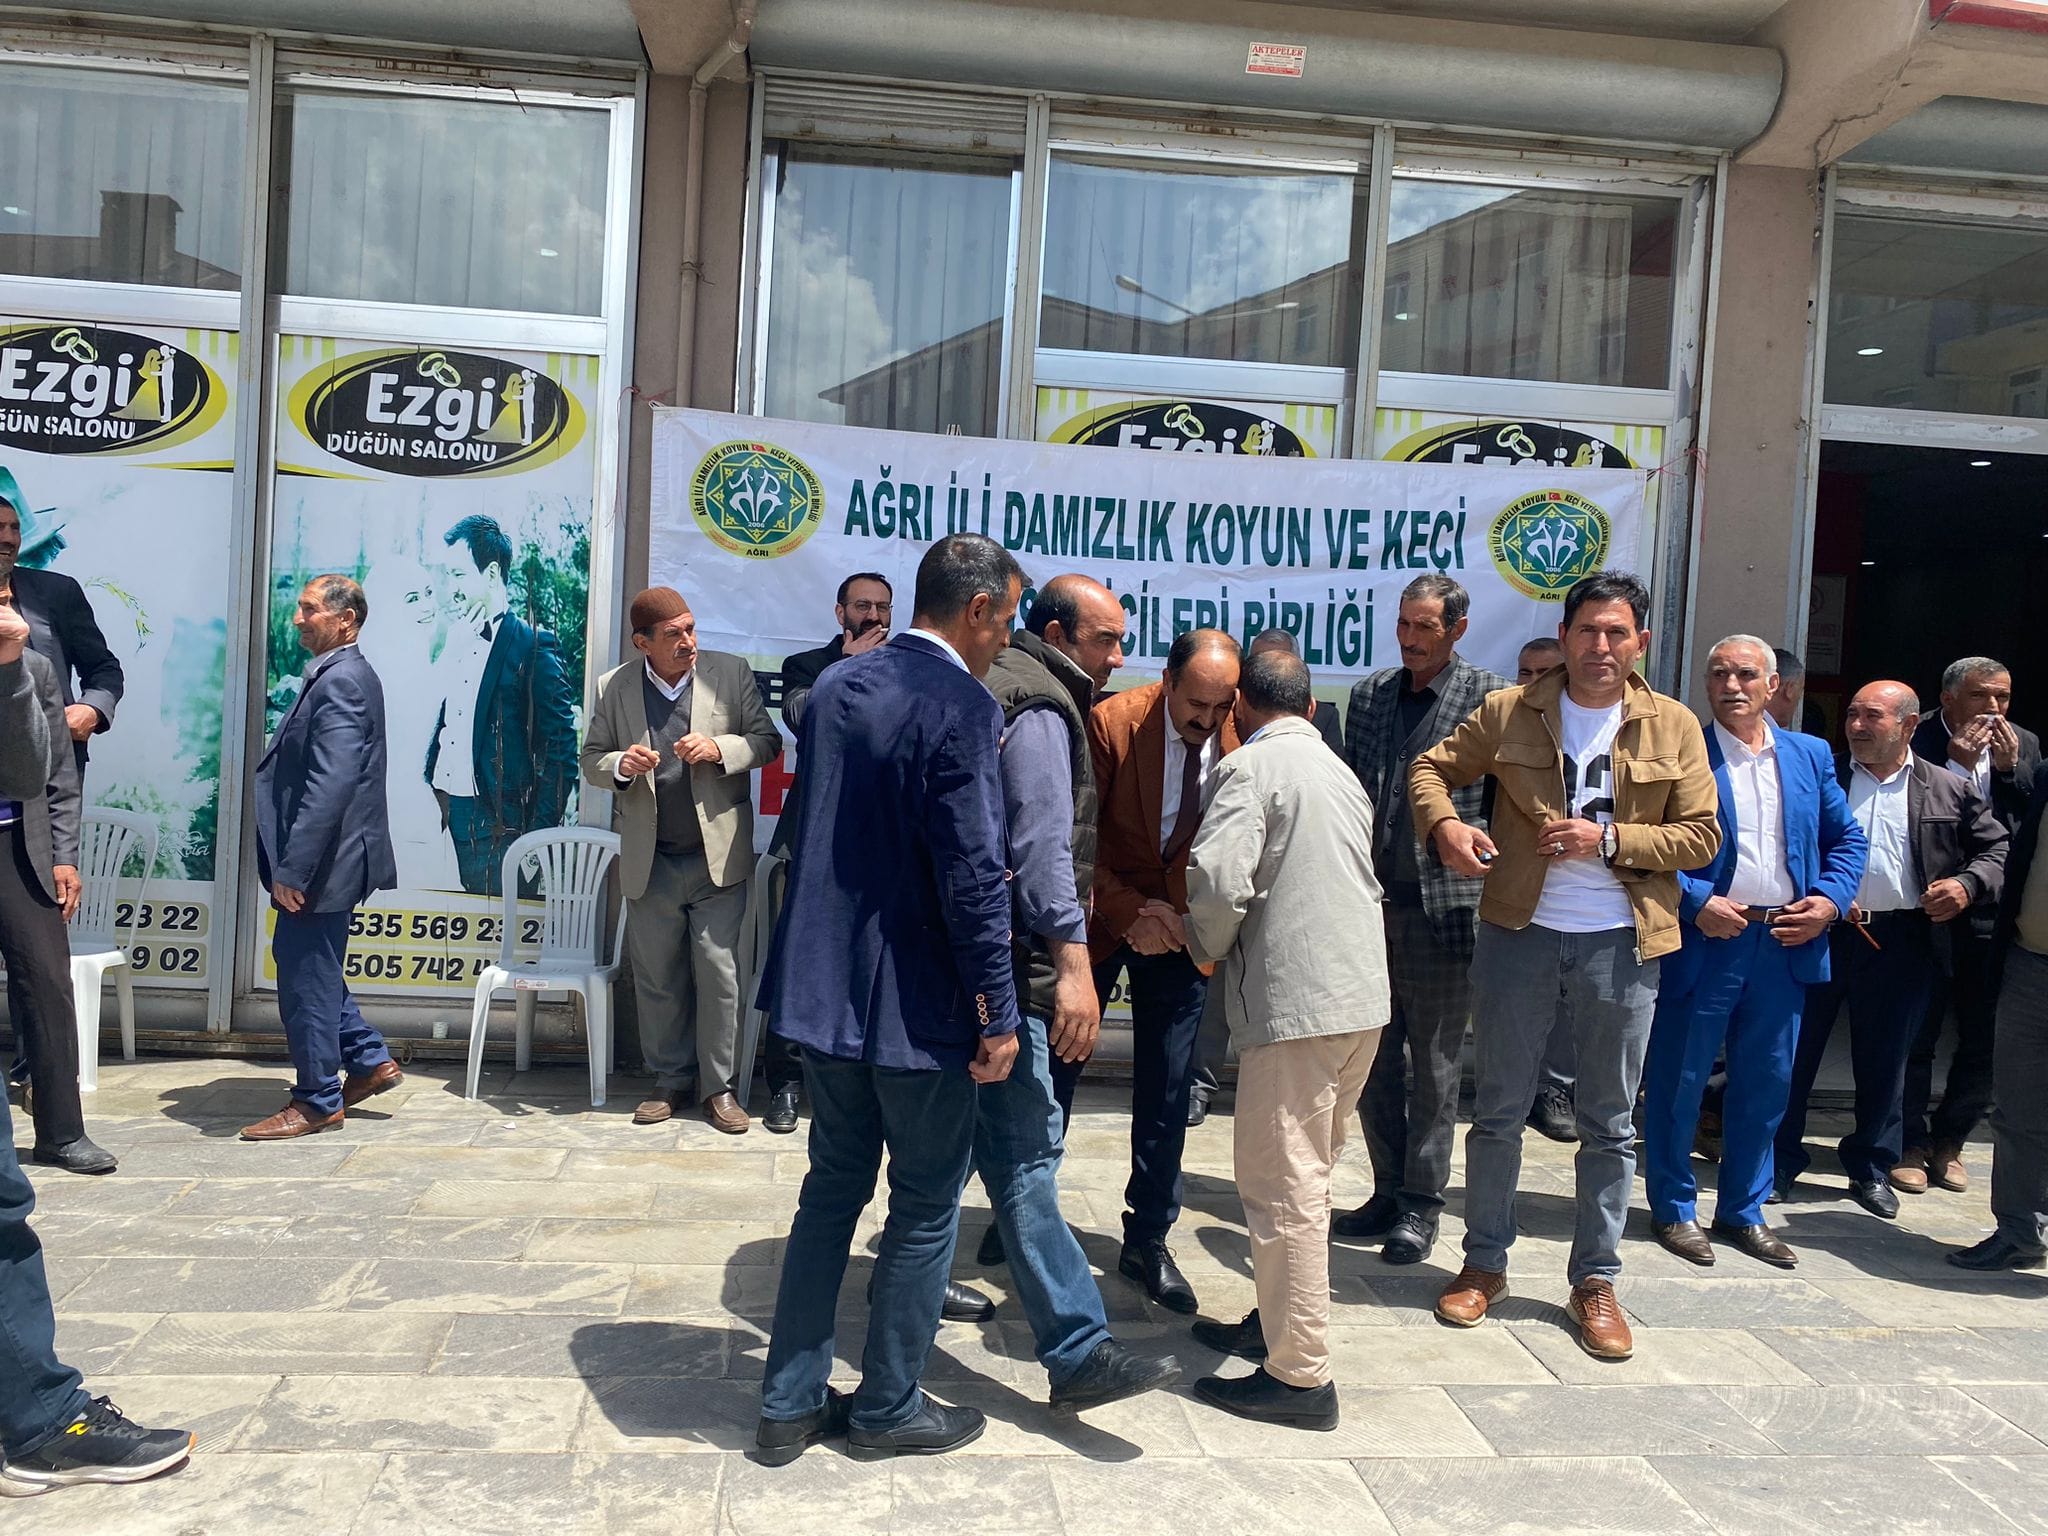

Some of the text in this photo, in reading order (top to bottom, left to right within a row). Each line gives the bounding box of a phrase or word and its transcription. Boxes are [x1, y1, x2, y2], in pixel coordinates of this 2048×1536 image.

[1252, 46, 1304, 57] AKTEPELER
[0, 348, 134, 418] Ezgi
[366, 372, 496, 441] Ezgi
[44, 416, 136, 439] SALONU
[327, 430, 497, 462] DÜĞÜN SALONU
[696, 451, 722, 485] DAMIZLIK
[720, 443, 749, 456] KOYUN
[1520, 493, 1547, 508] KOYUN
[844, 464, 934, 541] AĞRI
[1003, 491, 1176, 562] DAMIZLIK
[1186, 502, 1312, 568] KOYUN
[1323, 508, 1371, 570] VE
[1381, 496, 1467, 575] KEÇİ
[746, 548, 769, 557] AĞRI
[1540, 592, 1560, 600] AĞRI
[161, 905, 199, 930] 22
[410, 915, 469, 940] 569
[160, 947, 200, 972] 02
[345, 953, 403, 979] 505
[410, 956, 465, 981] 742
